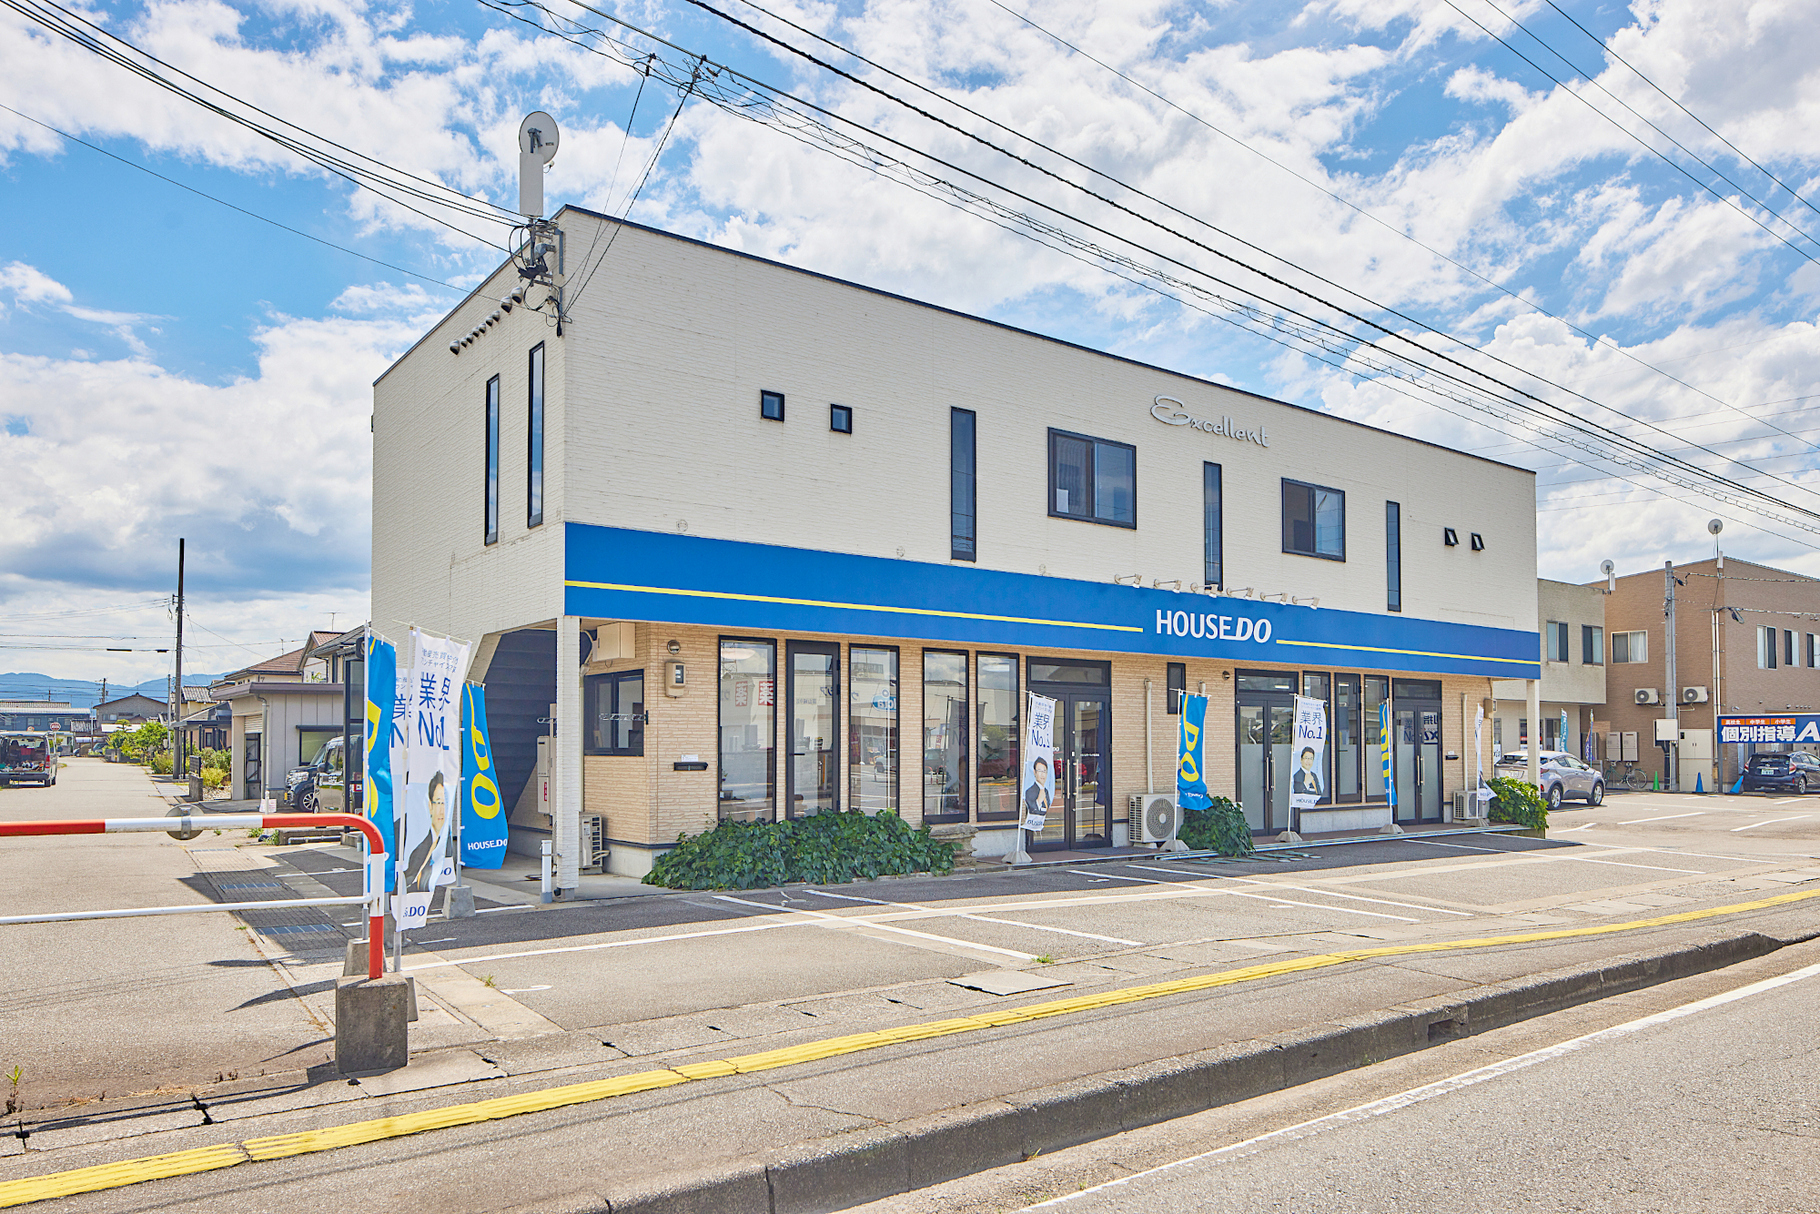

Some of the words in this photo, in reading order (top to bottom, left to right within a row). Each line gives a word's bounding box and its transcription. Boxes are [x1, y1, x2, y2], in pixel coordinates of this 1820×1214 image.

[1150, 394, 1270, 448] Excellent
[419, 671, 451, 711] 業界
[1300, 710, 1323, 725] 業界
[1299, 725, 1323, 739] No.1
[1721, 726, 1796, 742] 個別指導
